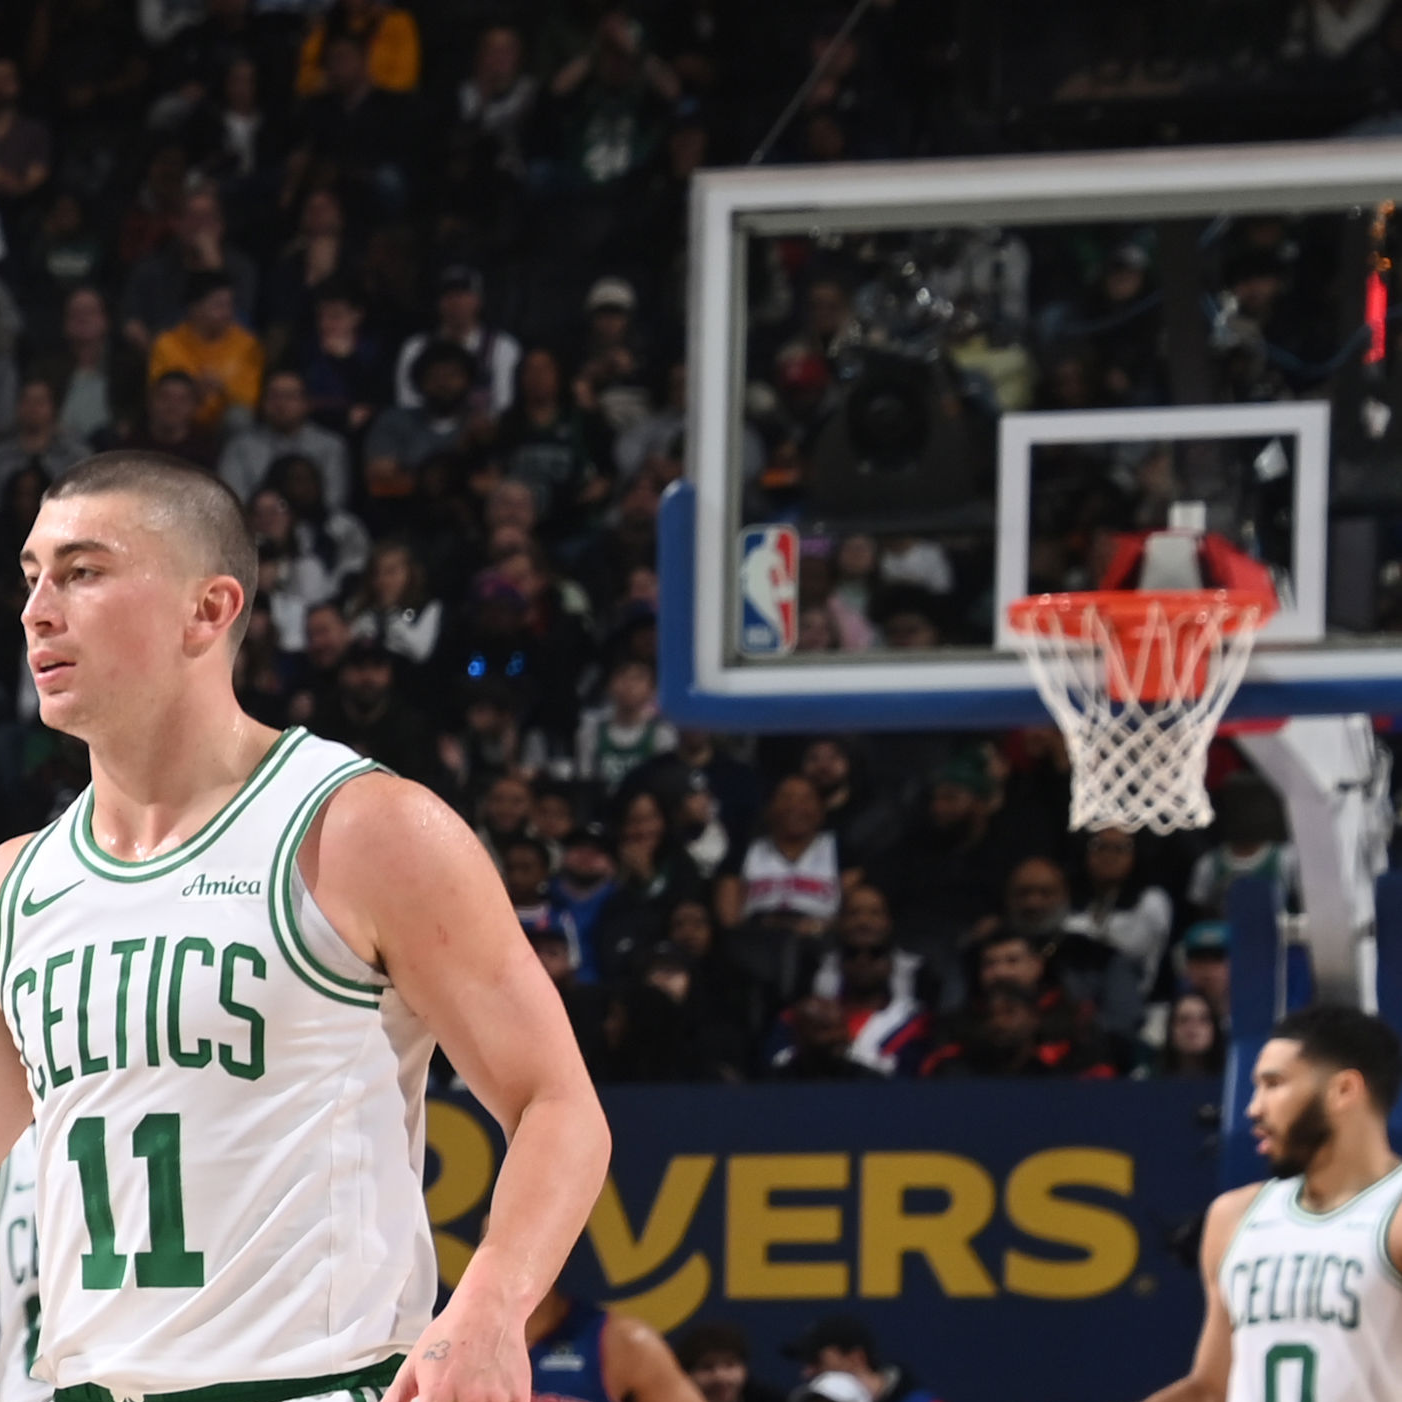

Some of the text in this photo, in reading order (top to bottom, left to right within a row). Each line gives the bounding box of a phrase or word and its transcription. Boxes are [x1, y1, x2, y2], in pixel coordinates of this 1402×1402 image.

[181, 873, 262, 897] Amica
[11, 936, 267, 1101] CELTICS
[67, 1112, 205, 1290] 11
[1232, 1253, 1364, 1330] CELTICS
